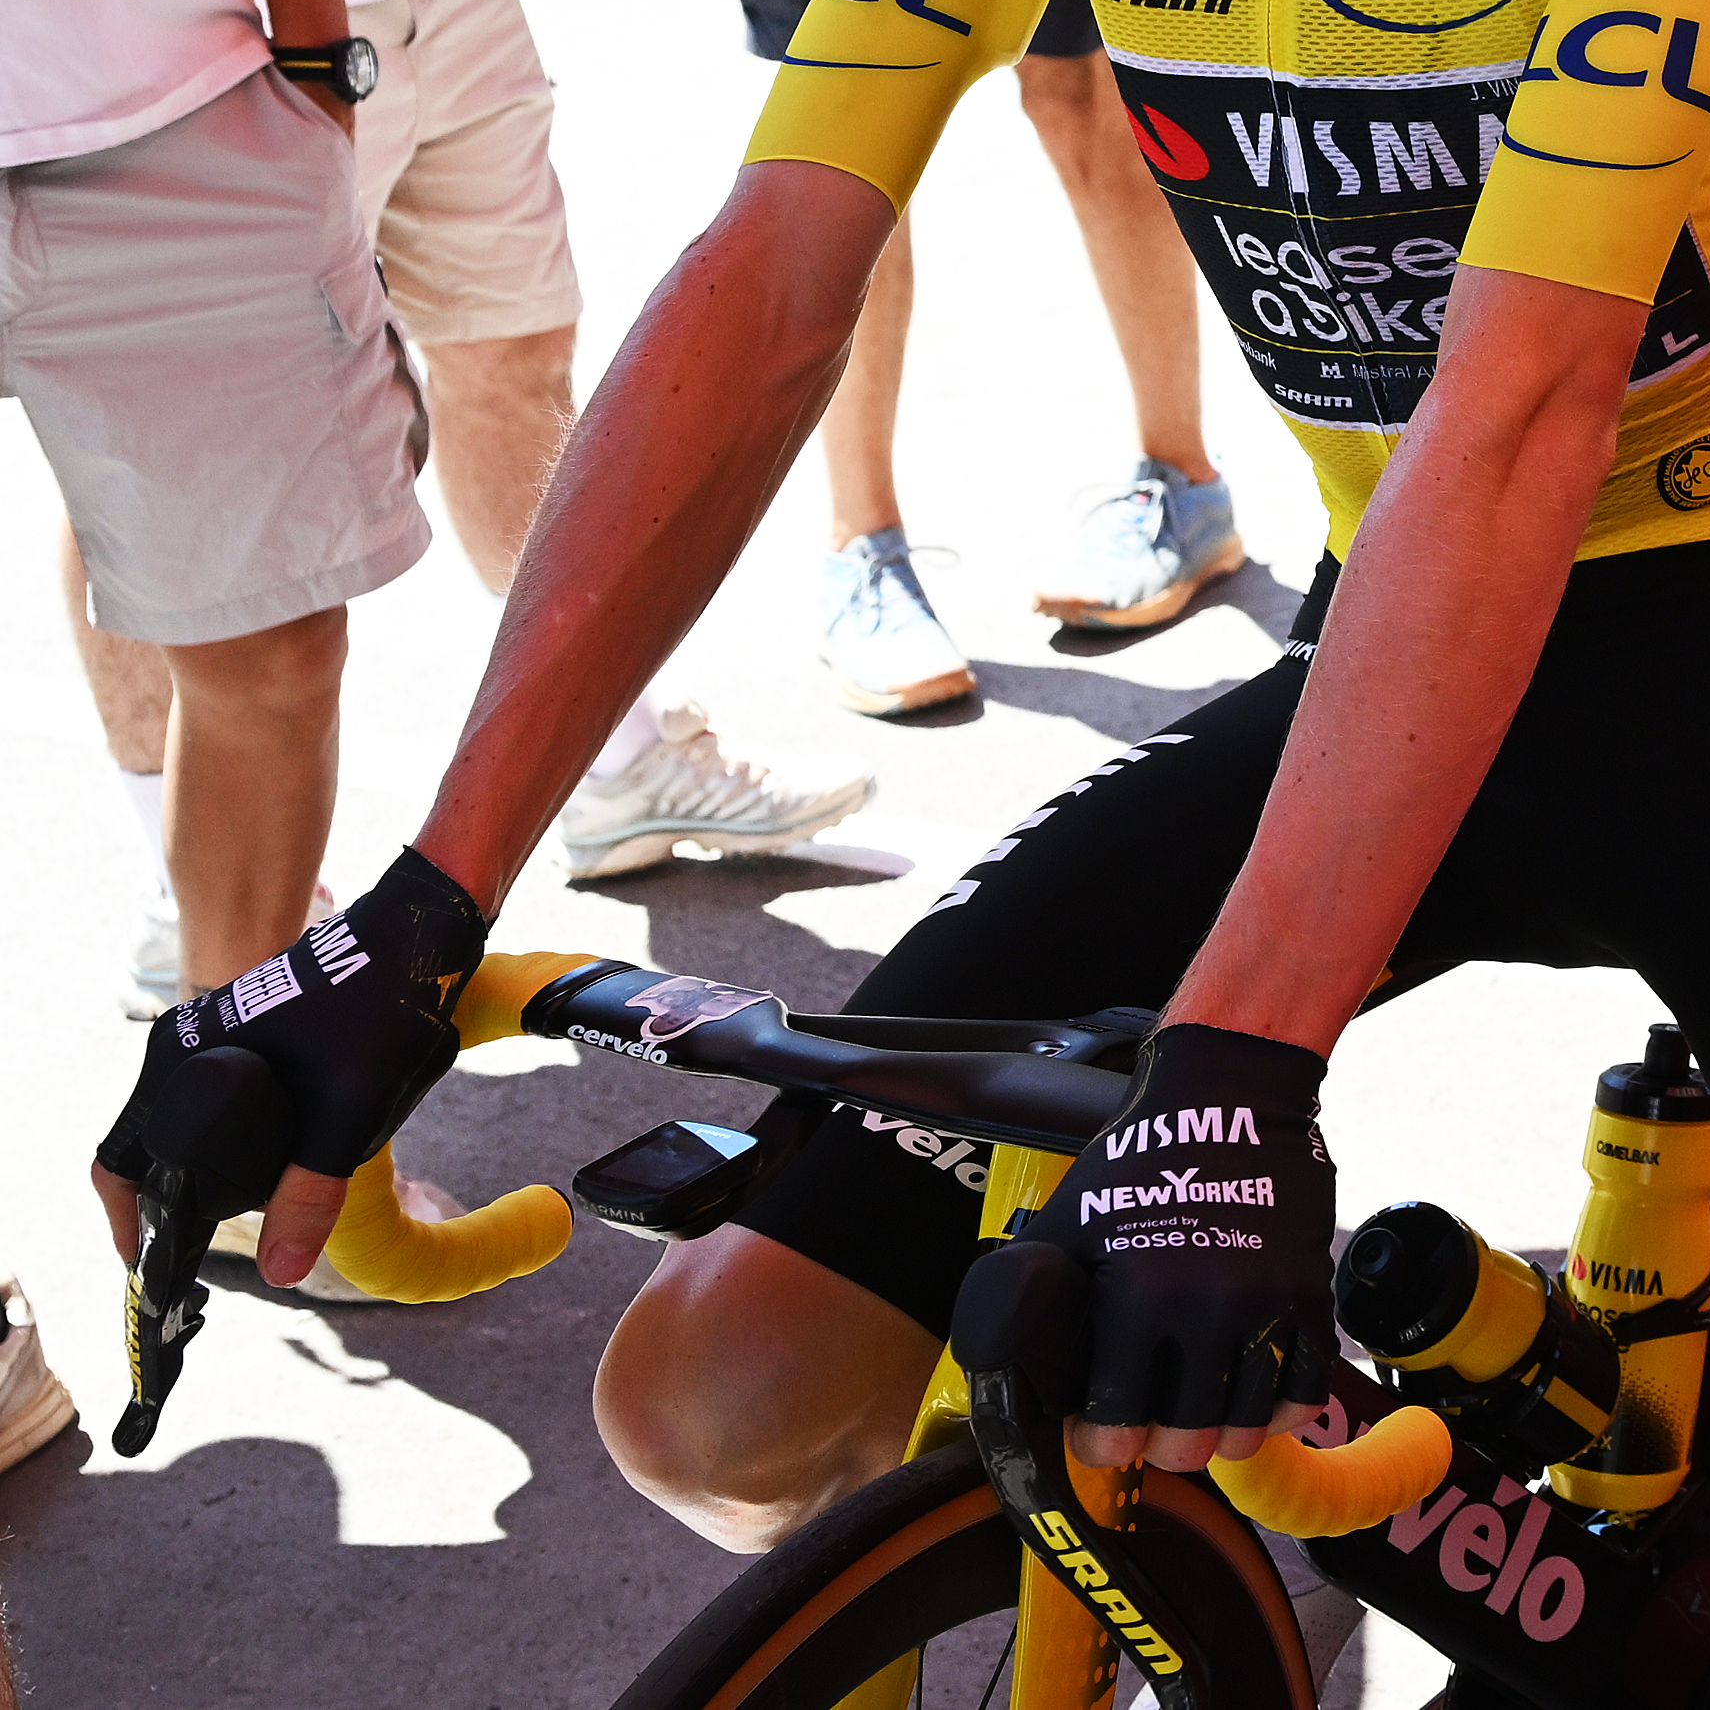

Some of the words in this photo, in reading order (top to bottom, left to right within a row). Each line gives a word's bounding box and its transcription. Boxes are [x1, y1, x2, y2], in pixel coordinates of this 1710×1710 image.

[1214, 215, 1458, 288] lease
[1352, 363, 1413, 382] Mistral
[1273, 383, 1354, 409] SRAM
[215, 993, 241, 1033] FINANCE
[1105, 1106, 1261, 1161] VISMA
[1080, 1167, 1275, 1227] NEWYORKER
[1104, 1229, 1186, 1253] lease
[1116, 1216, 1178, 1233] serviced
[1181, 1215, 1199, 1229] by
[1590, 1261, 1664, 1297] VISMA
[1030, 1511, 1187, 1677] SRAM
